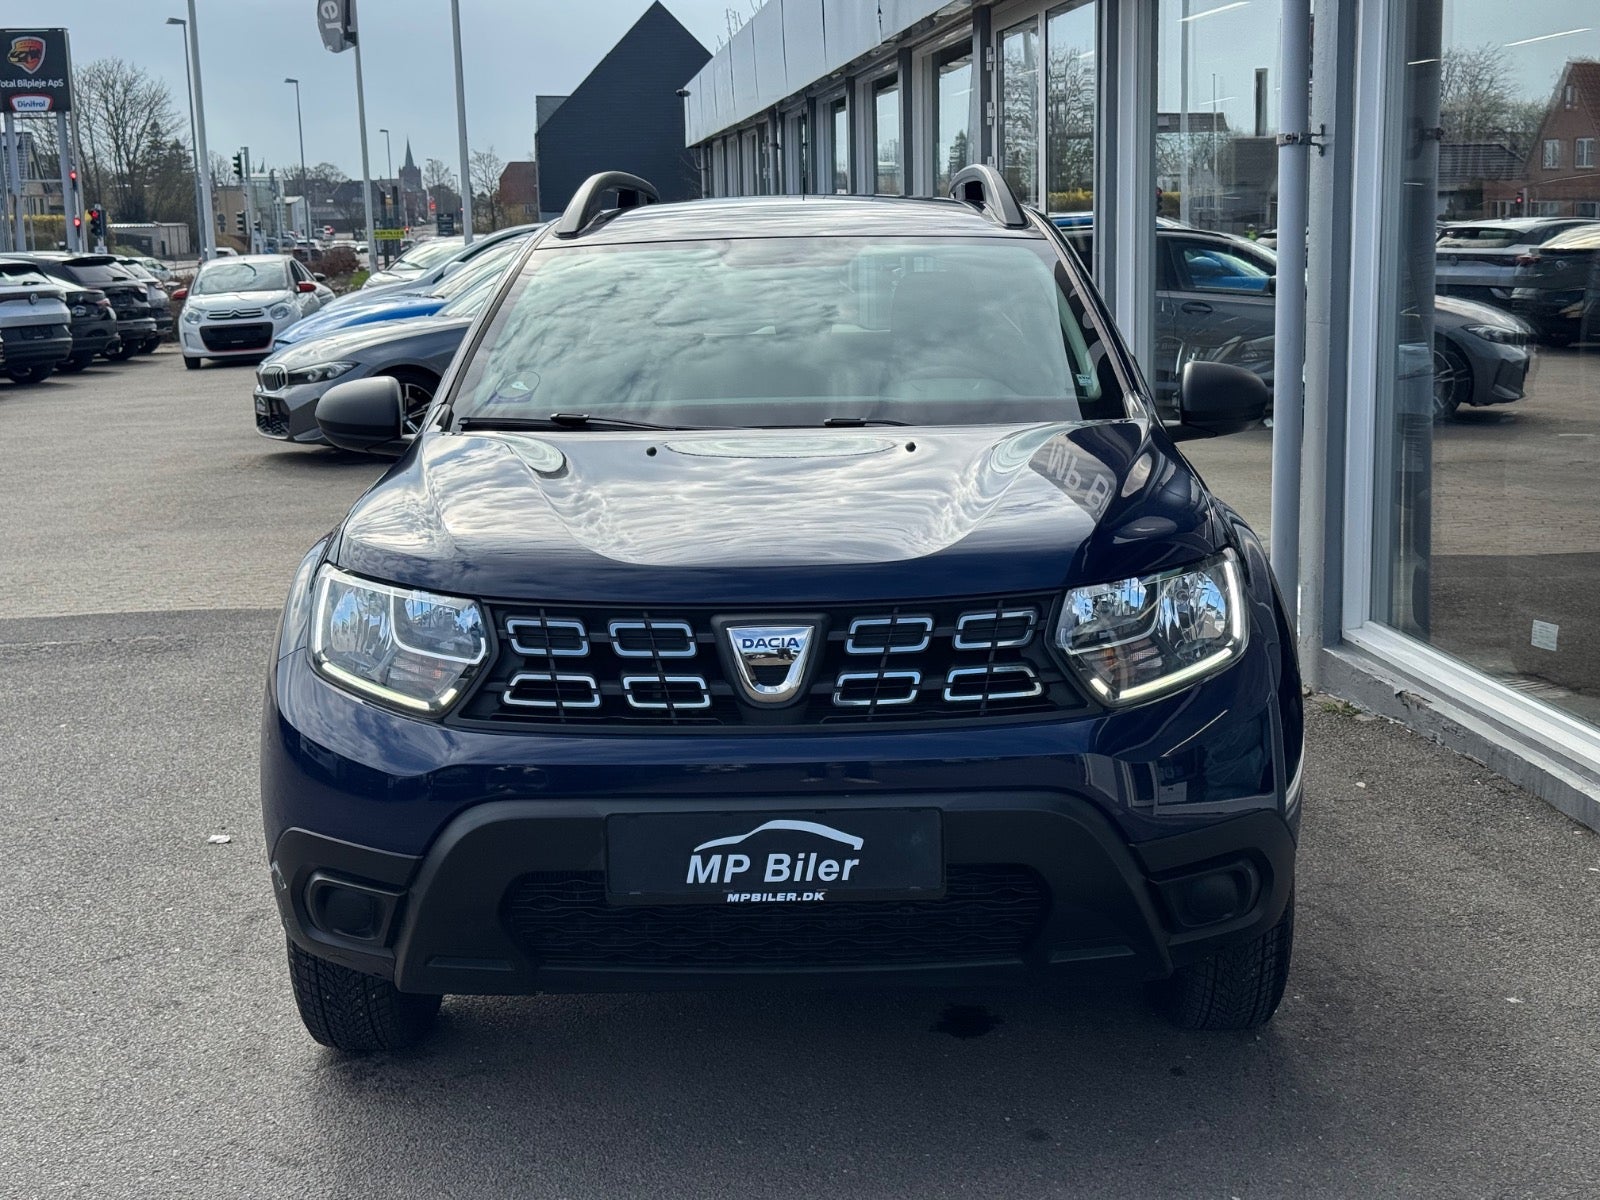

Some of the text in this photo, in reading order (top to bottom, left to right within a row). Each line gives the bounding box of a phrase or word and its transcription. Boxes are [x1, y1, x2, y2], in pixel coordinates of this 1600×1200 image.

[0, 79, 64, 89] otal Bilpleje ApS
[17, 100, 46, 108] Dinitrol
[742, 637, 799, 649] DACIA
[686, 852, 860, 884] MP Biler
[726, 892, 825, 903] MPBILER.DK
